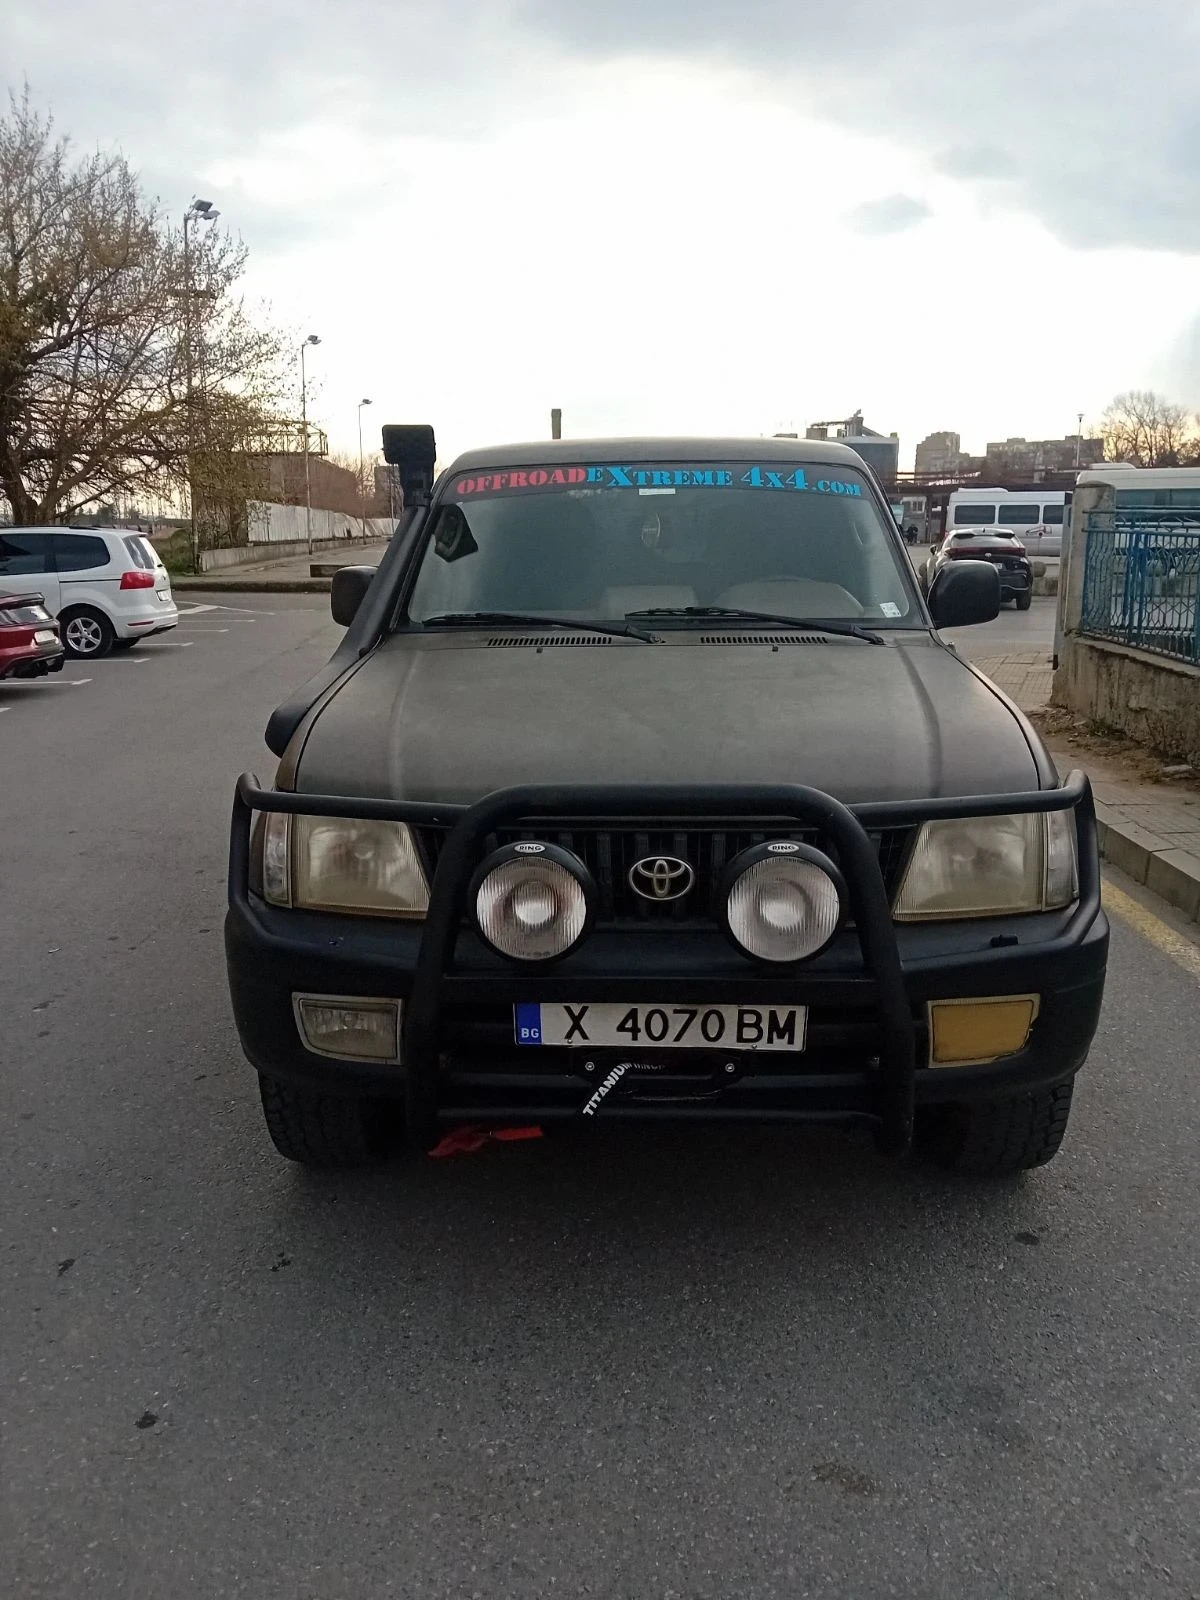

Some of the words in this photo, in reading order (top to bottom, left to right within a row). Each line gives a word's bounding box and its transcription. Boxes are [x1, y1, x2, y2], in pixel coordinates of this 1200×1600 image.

[521, 1027, 540, 1039] BG
[563, 1005, 590, 1041] X
[616, 1007, 726, 1043] 4070
[736, 1008, 797, 1045] BM
